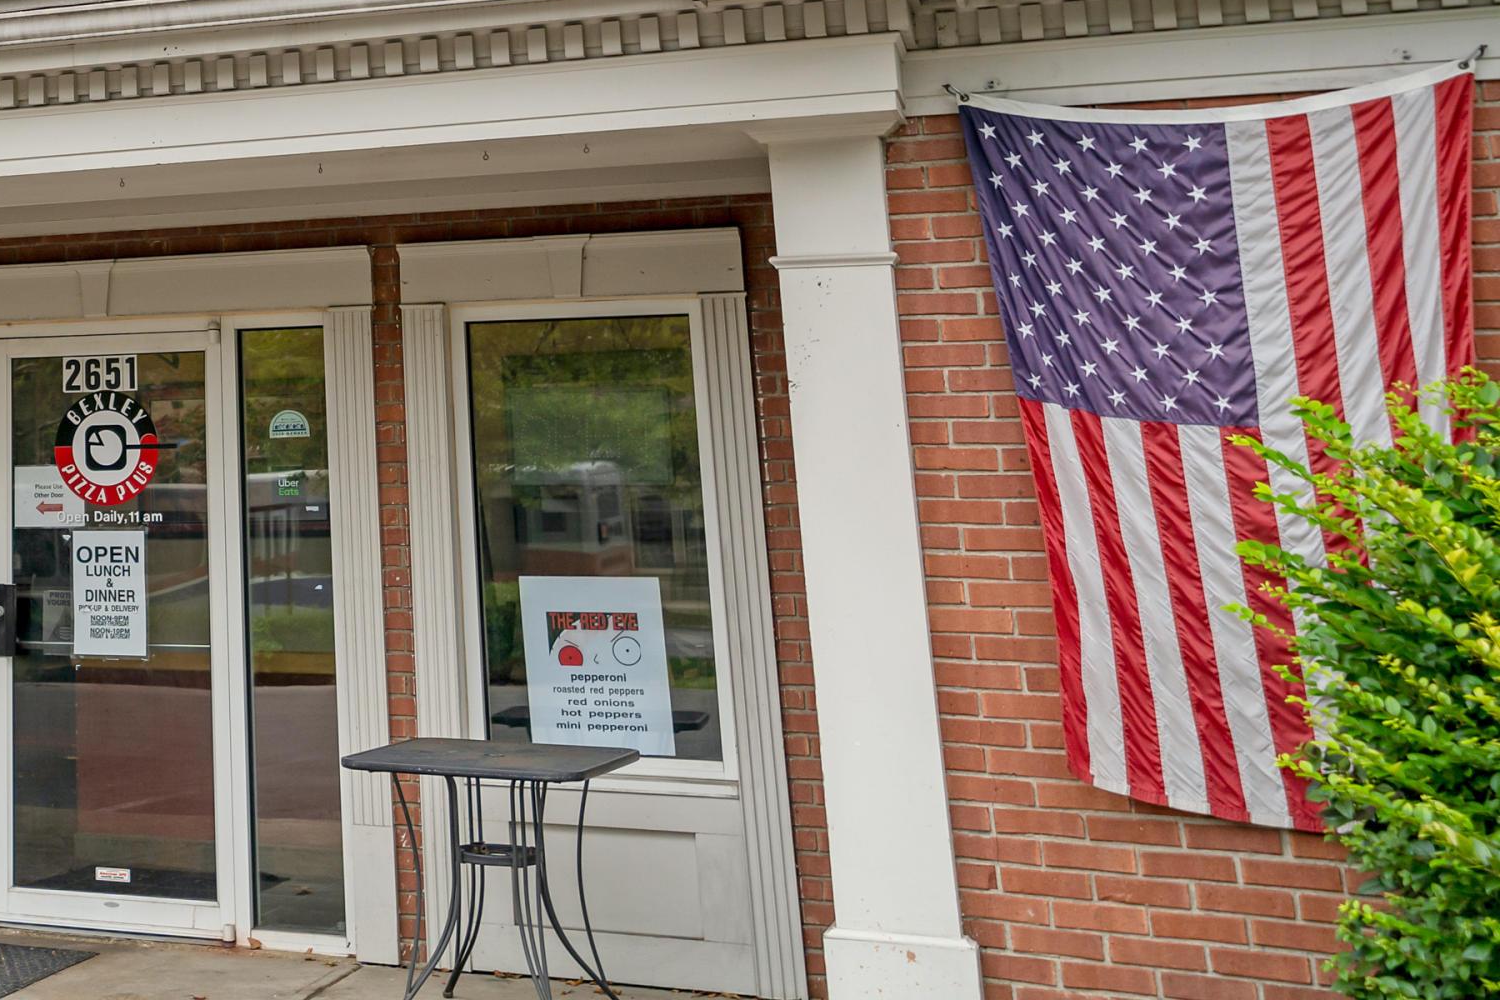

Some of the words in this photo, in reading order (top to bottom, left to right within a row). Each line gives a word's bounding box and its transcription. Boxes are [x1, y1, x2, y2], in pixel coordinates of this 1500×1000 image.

[65, 357, 136, 391] 2651
[66, 392, 148, 426] BEXLEY
[61, 463, 107, 504] PIZZA
[116, 461, 154, 501] PLUS
[277, 479, 299, 487] Uber
[278, 488, 300, 496] Eats
[57, 511, 90, 525] Open
[93, 510, 128, 525] Daily,
[128, 511, 141, 523] 11
[143, 512, 163, 523] am
[76, 545, 140, 564] OPEN
[85, 564, 131, 577] LUNCH
[106, 577, 114, 588] &
[85, 589, 136, 603] DINNER
[111, 604, 139, 613] DELIVERY
[547, 612, 578, 631] THE
[579, 612, 609, 631] RED
[611, 612, 639, 631] EYE
[570, 673, 627, 683] pepperoni
[552, 685, 586, 694] roasted
[589, 686, 605, 695] red
[608, 687, 645, 697] peppers
[567, 697, 588, 706] red
[593, 698, 635, 708] onions
[561, 708, 582, 717] hot
[588, 710, 642, 720] peppers
[556, 721, 581, 730] mini
[587, 722, 649, 733] pepperoni
